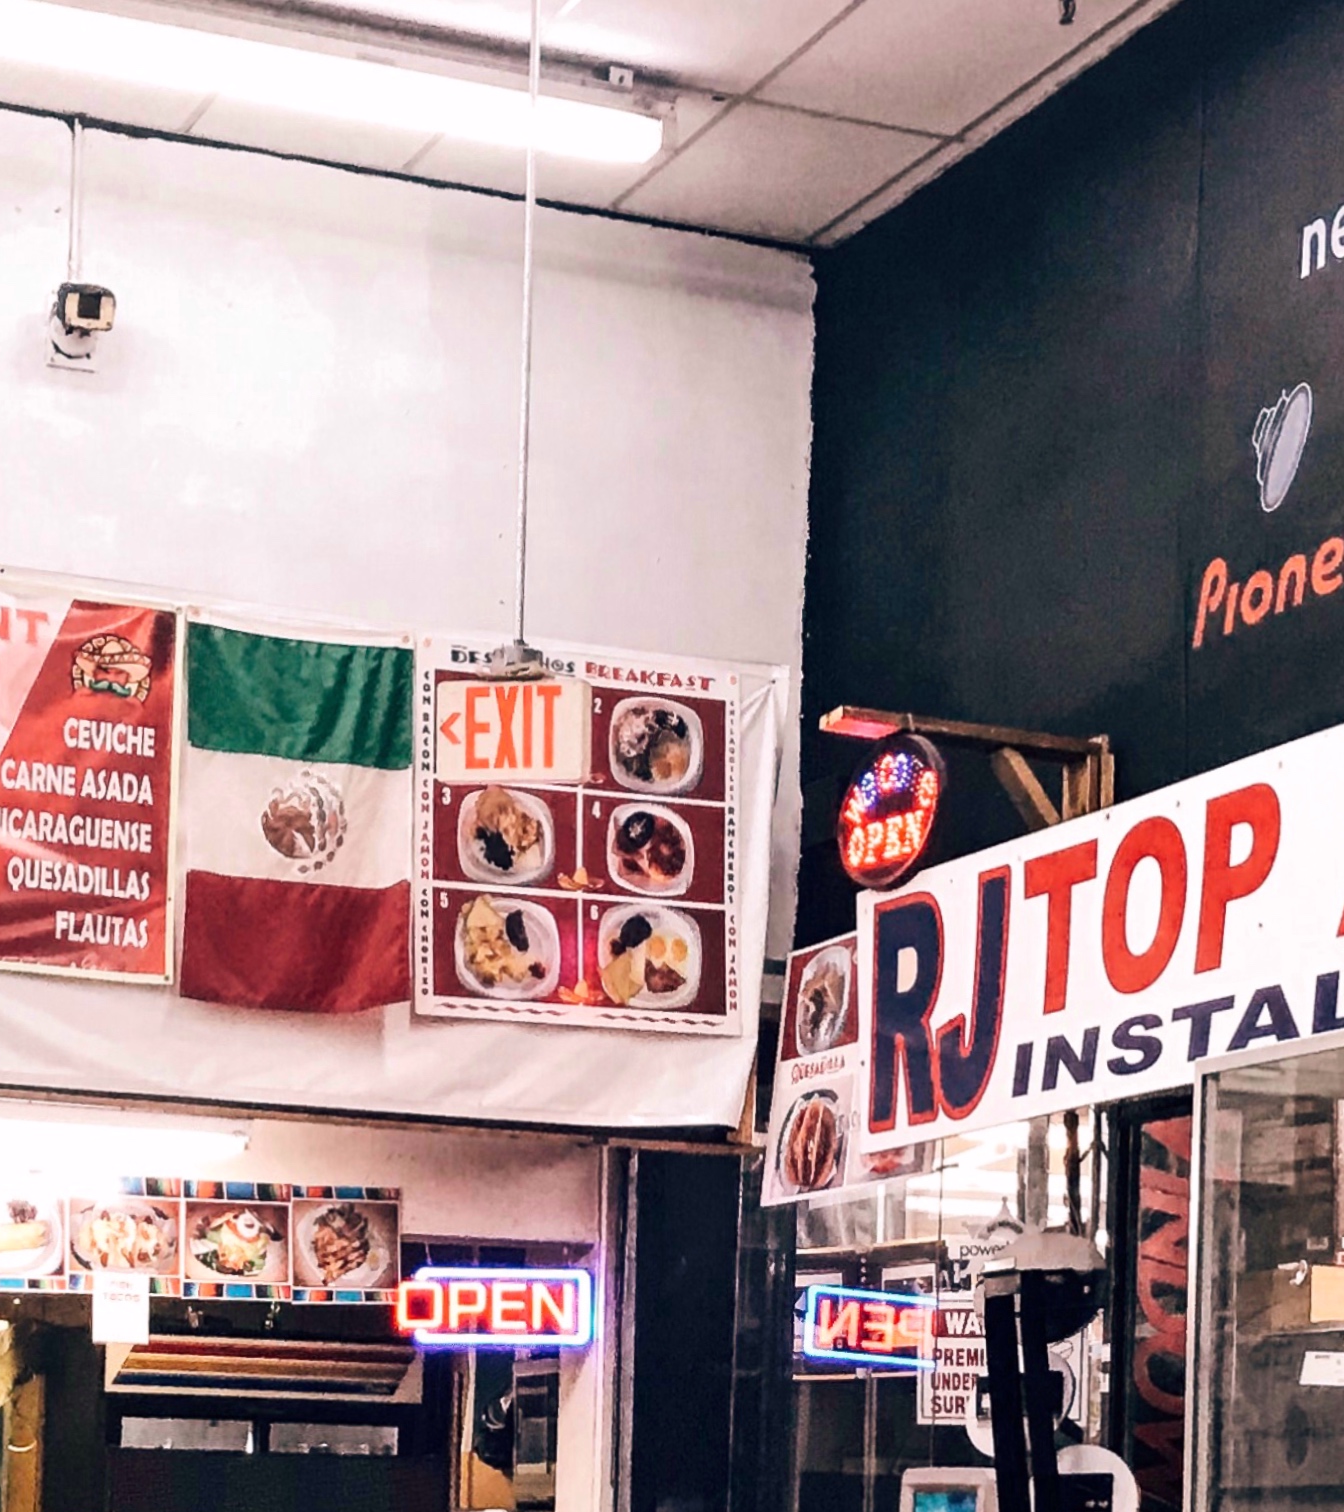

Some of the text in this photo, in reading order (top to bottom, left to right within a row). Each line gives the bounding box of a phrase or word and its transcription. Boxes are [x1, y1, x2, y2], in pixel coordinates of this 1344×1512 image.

[584, 660, 717, 693] BREAKFAST
[464, 685, 563, 770] EXIT
[593, 697, 603, 714] 2
[62, 716, 156, 758] CEVICHE
[421, 711, 431, 772] BACON
[0, 758, 154, 806] CARNE ASADA
[441, 786, 452, 807] 3
[591, 801, 601, 820] 4
[420, 819, 432, 881] JAMON
[847, 809, 925, 867] OPEN
[6, 856, 151, 902] QUESADILLAS
[439, 891, 449, 909] 5
[54, 910, 149, 949] FLAUTAS
[590, 904, 599, 921] 6
[867, 862, 1012, 1136] RJ
[1020, 779, 1283, 1018] TOP
[395, 1279, 576, 1336] OPEN
